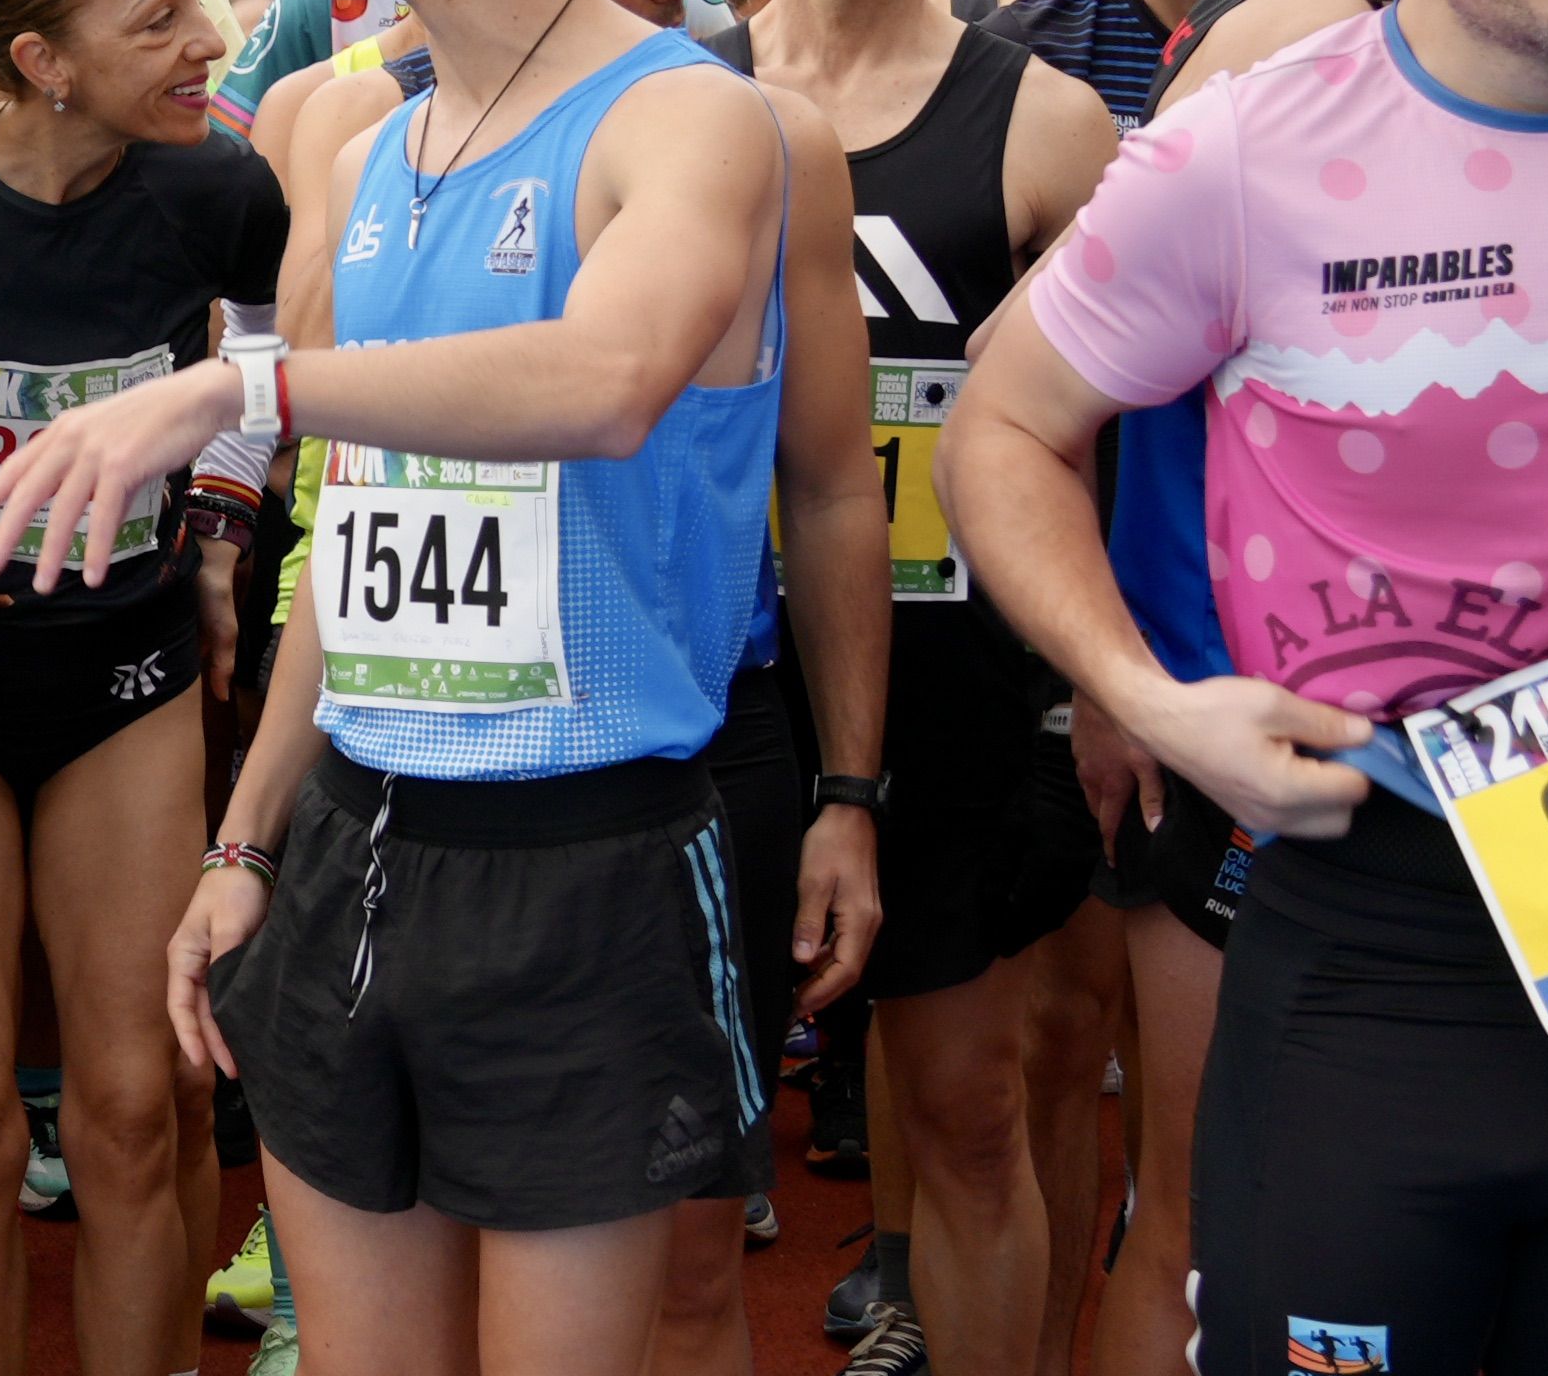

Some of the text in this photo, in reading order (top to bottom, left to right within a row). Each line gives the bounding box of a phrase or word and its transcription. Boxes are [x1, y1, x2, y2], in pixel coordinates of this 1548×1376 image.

[1321, 243, 1514, 295] IMPARABLES
[1321, 282, 1515, 315] 24H NON STOP CONTRA LA ELA
[874, 403, 907, 421] 2026
[439, 461, 473, 484] 2026
[336, 511, 508, 627] 1544
[1319, 573, 1412, 635] LA
[1436, 578, 1544, 662] EL
[1224, 847, 1252, 867] Clu
